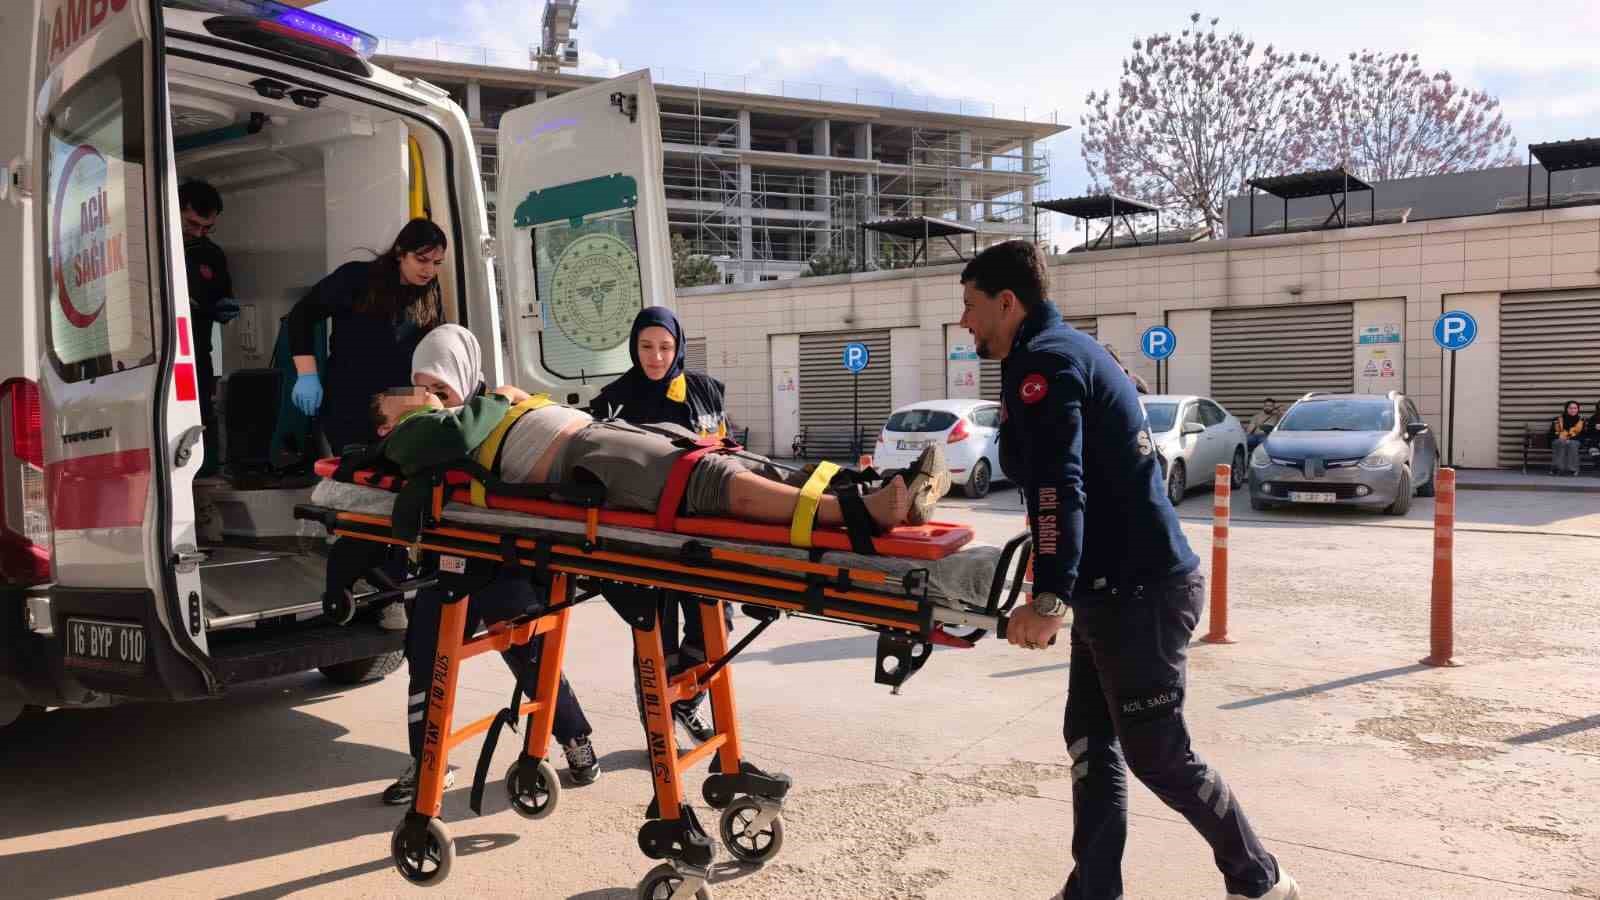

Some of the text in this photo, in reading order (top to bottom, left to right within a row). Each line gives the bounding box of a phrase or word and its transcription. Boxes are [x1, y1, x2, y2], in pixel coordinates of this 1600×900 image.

[48, 0, 128, 63] AMB
[1150, 331, 1167, 354] P
[1444, 317, 1466, 344] P
[849, 347, 862, 367] P
[1039, 514, 1061, 555] SAĞLIK
[74, 623, 143, 662] 16 BYP 010
[640, 657, 657, 688] PLUS
[426, 720, 439, 744] TAY
[434, 650, 449, 680] PLUS
[651, 731, 667, 756] TAY
